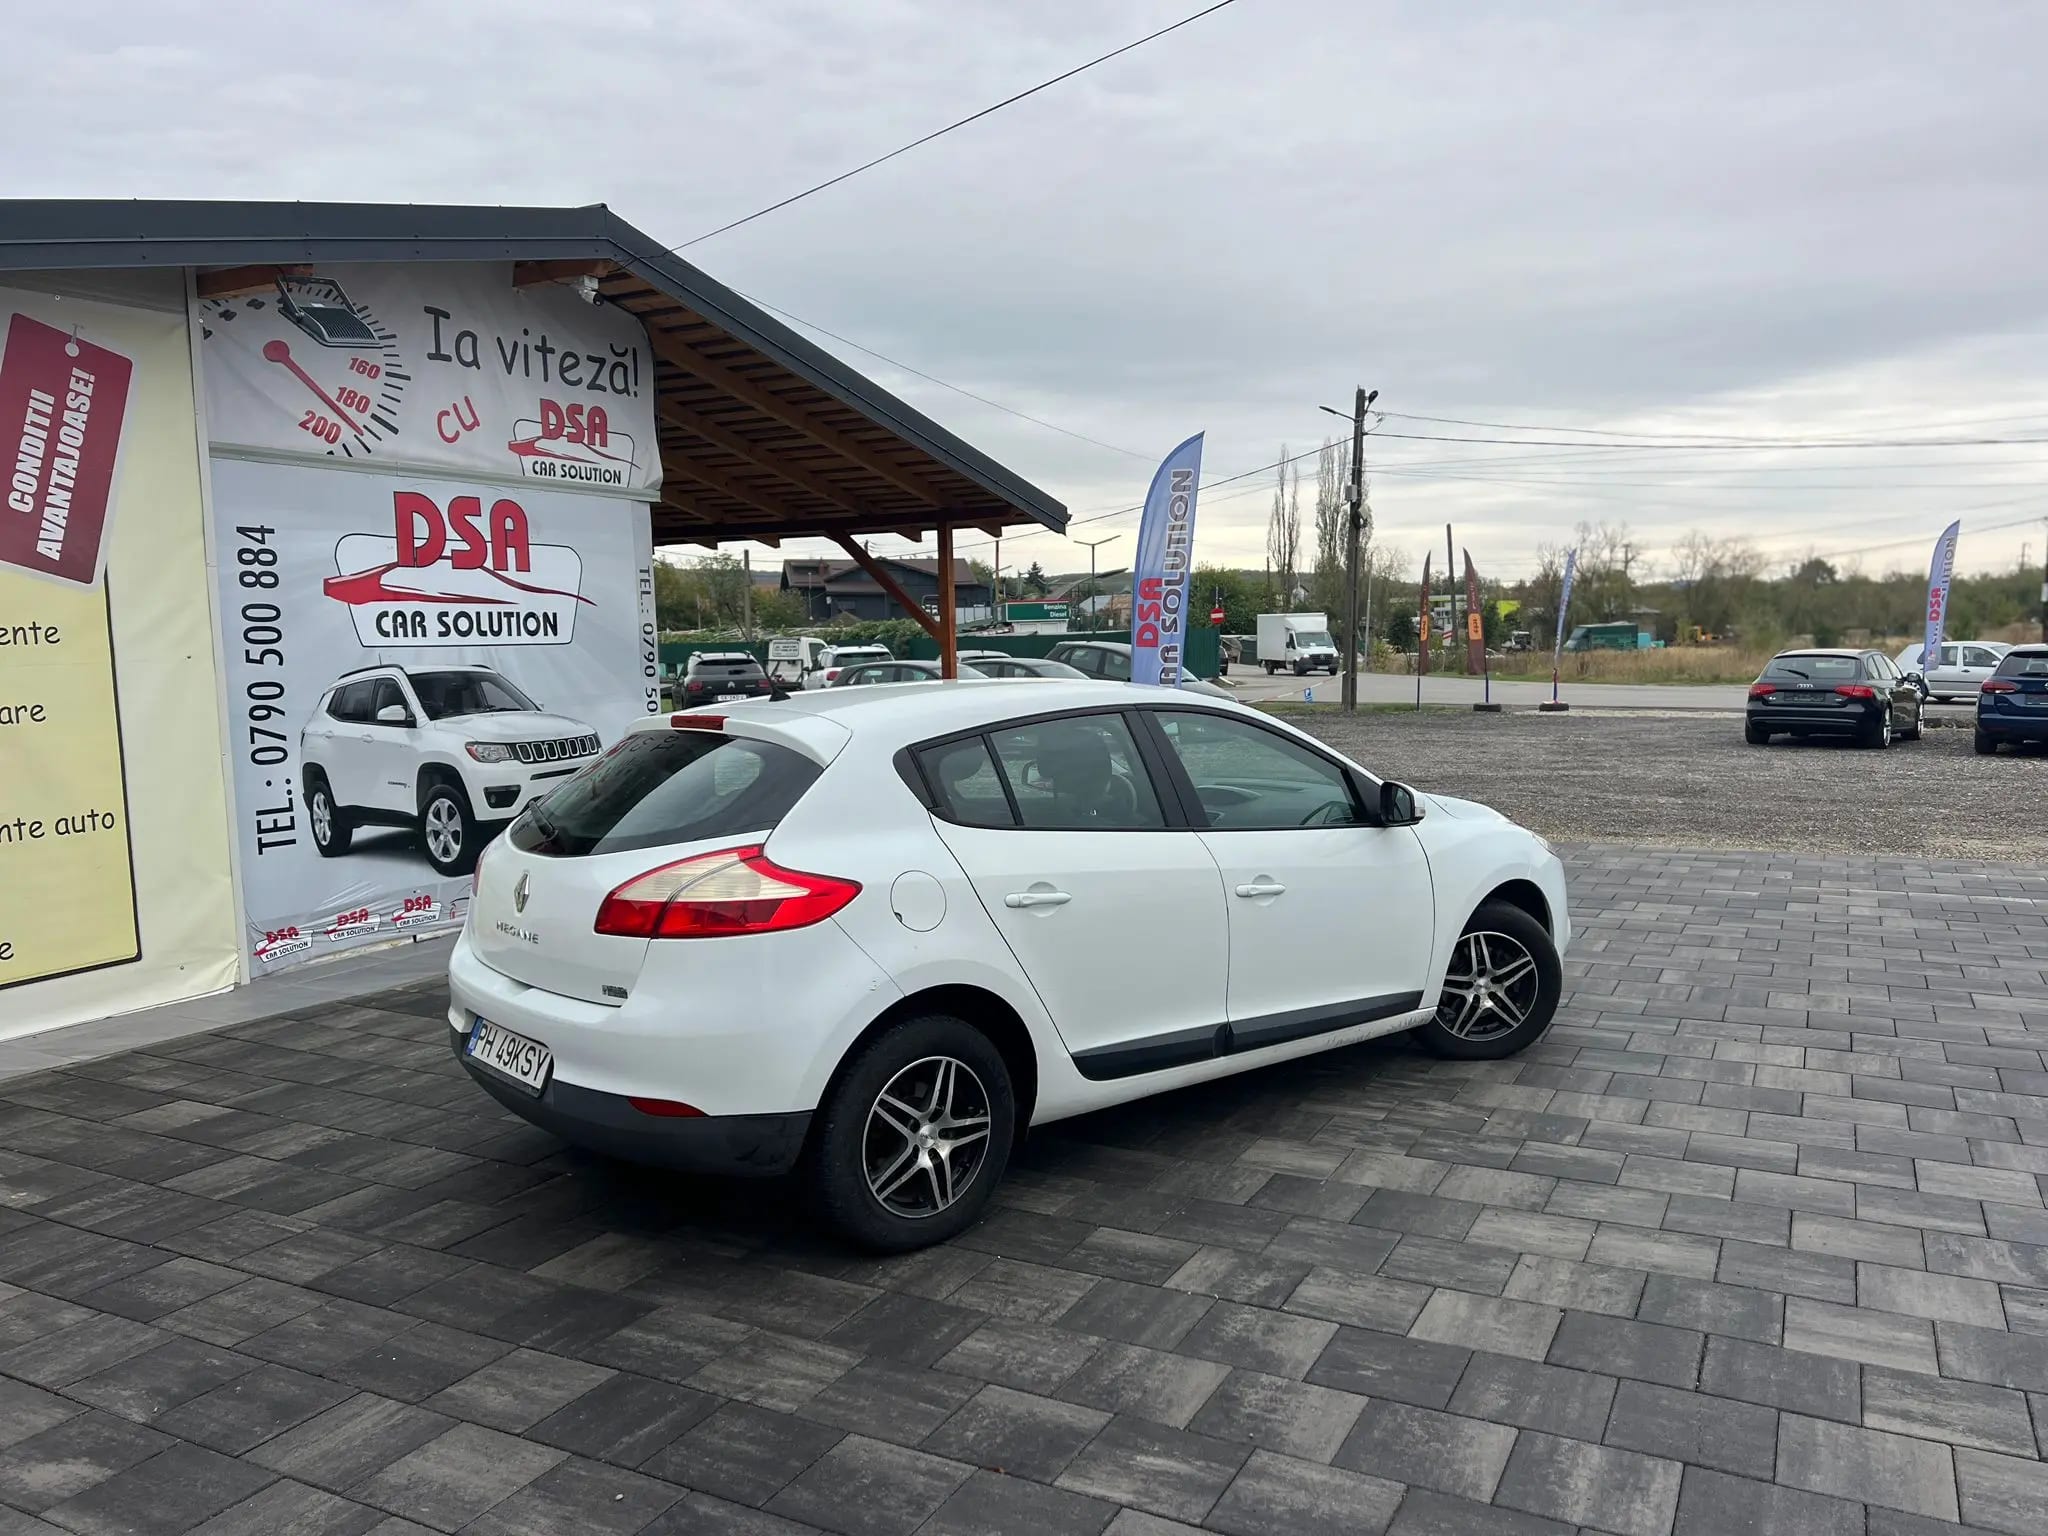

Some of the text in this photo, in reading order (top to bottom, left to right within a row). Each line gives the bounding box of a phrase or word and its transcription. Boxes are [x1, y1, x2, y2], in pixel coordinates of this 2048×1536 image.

[423, 305, 639, 398] Ia viteză!
[348, 357, 381, 380] 160
[335, 386, 371, 414] 180
[298, 409, 342, 445] 200
[437, 395, 480, 444] cu
[539, 398, 608, 448] DSA
[8, 388, 55, 513] CONDITII
[36, 367, 96, 561] AVANTAJOASE!
[532, 460, 621, 484] CAR SOLUTION
[393, 490, 531, 572] DSA
[1160, 468, 1194, 635] SOLUTION
[1135, 577, 1163, 648] DSA
[1928, 587, 1941, 622] DSA
[375, 610, 558, 638] CAR SOLUTION
[642, 622, 656, 678] 0790
[236, 524, 297, 856] TEL.: 0790 500 884
[645, 687, 659, 716] 50
[54, 808, 115, 838] auto
[336, 908, 369, 927] DSA
[404, 894, 432, 913] DSA
[265, 926, 300, 944] DSA
[333, 926, 375, 940] CAR SOLUTION
[399, 913, 437, 927] CAR SOLUTION
[496, 920, 540, 944] MEGANE
[265, 941, 309, 960] CAR SOLUTION
[477, 1023, 550, 1082] PH 49KSY
